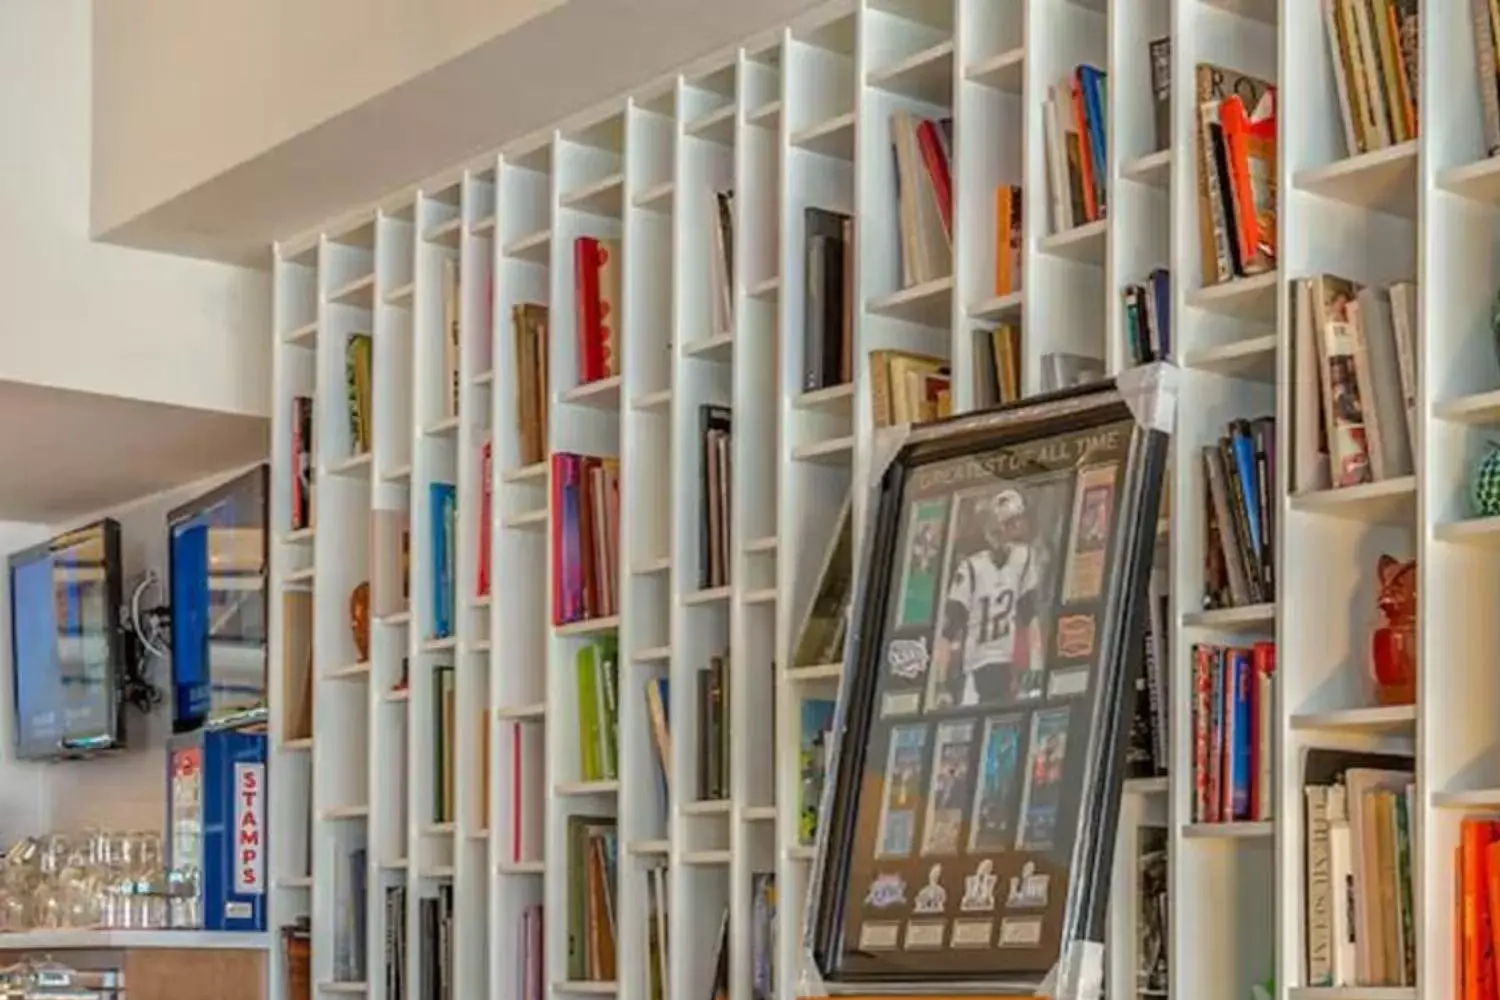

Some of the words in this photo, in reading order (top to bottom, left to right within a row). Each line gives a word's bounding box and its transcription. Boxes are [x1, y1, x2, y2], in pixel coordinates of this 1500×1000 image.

[1037, 442, 1072, 464] ALL
[978, 590, 1014, 644] 12
[240, 771, 259, 884] STAMPS
